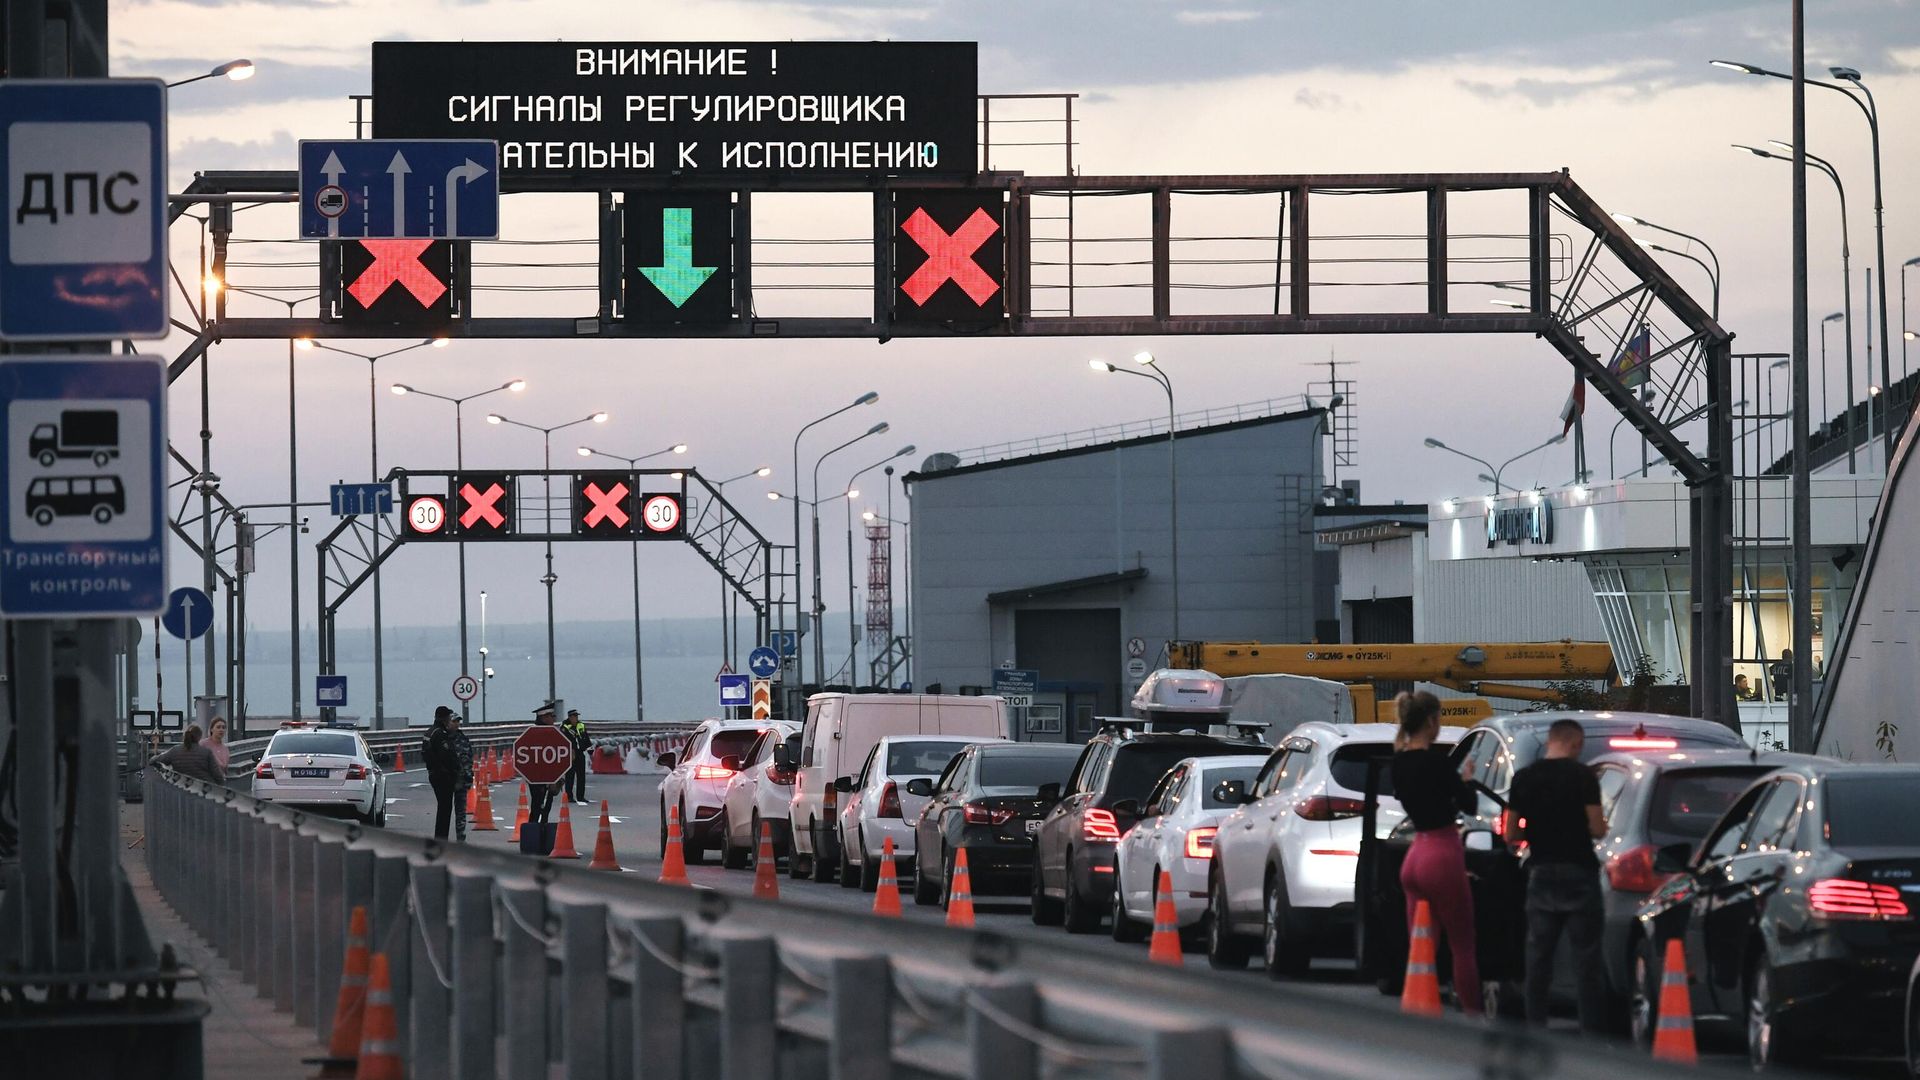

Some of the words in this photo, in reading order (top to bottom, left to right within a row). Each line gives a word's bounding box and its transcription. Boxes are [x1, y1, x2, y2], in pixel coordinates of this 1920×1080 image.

[577, 49, 747, 75] ВНИМАНИЕ
[771, 49, 777, 75] !
[448, 96, 601, 122] СИГНАЛЫ
[626, 96, 905, 125] РЕГУЛИРОВЩИКА
[503, 142, 655, 168] АТЕЛЬНЫ
[678, 142, 698, 168] К
[722, 142, 938, 168] ИСПОЛНЕНИЮ
[16, 170, 140, 225] ДПС
[416, 506, 437, 524] 30
[652, 505, 671, 522] 30
[4, 548, 161, 570] Транспортный
[30, 577, 132, 595] контроль
[458, 683, 473, 694] 30
[516, 745, 569, 764] STOP
